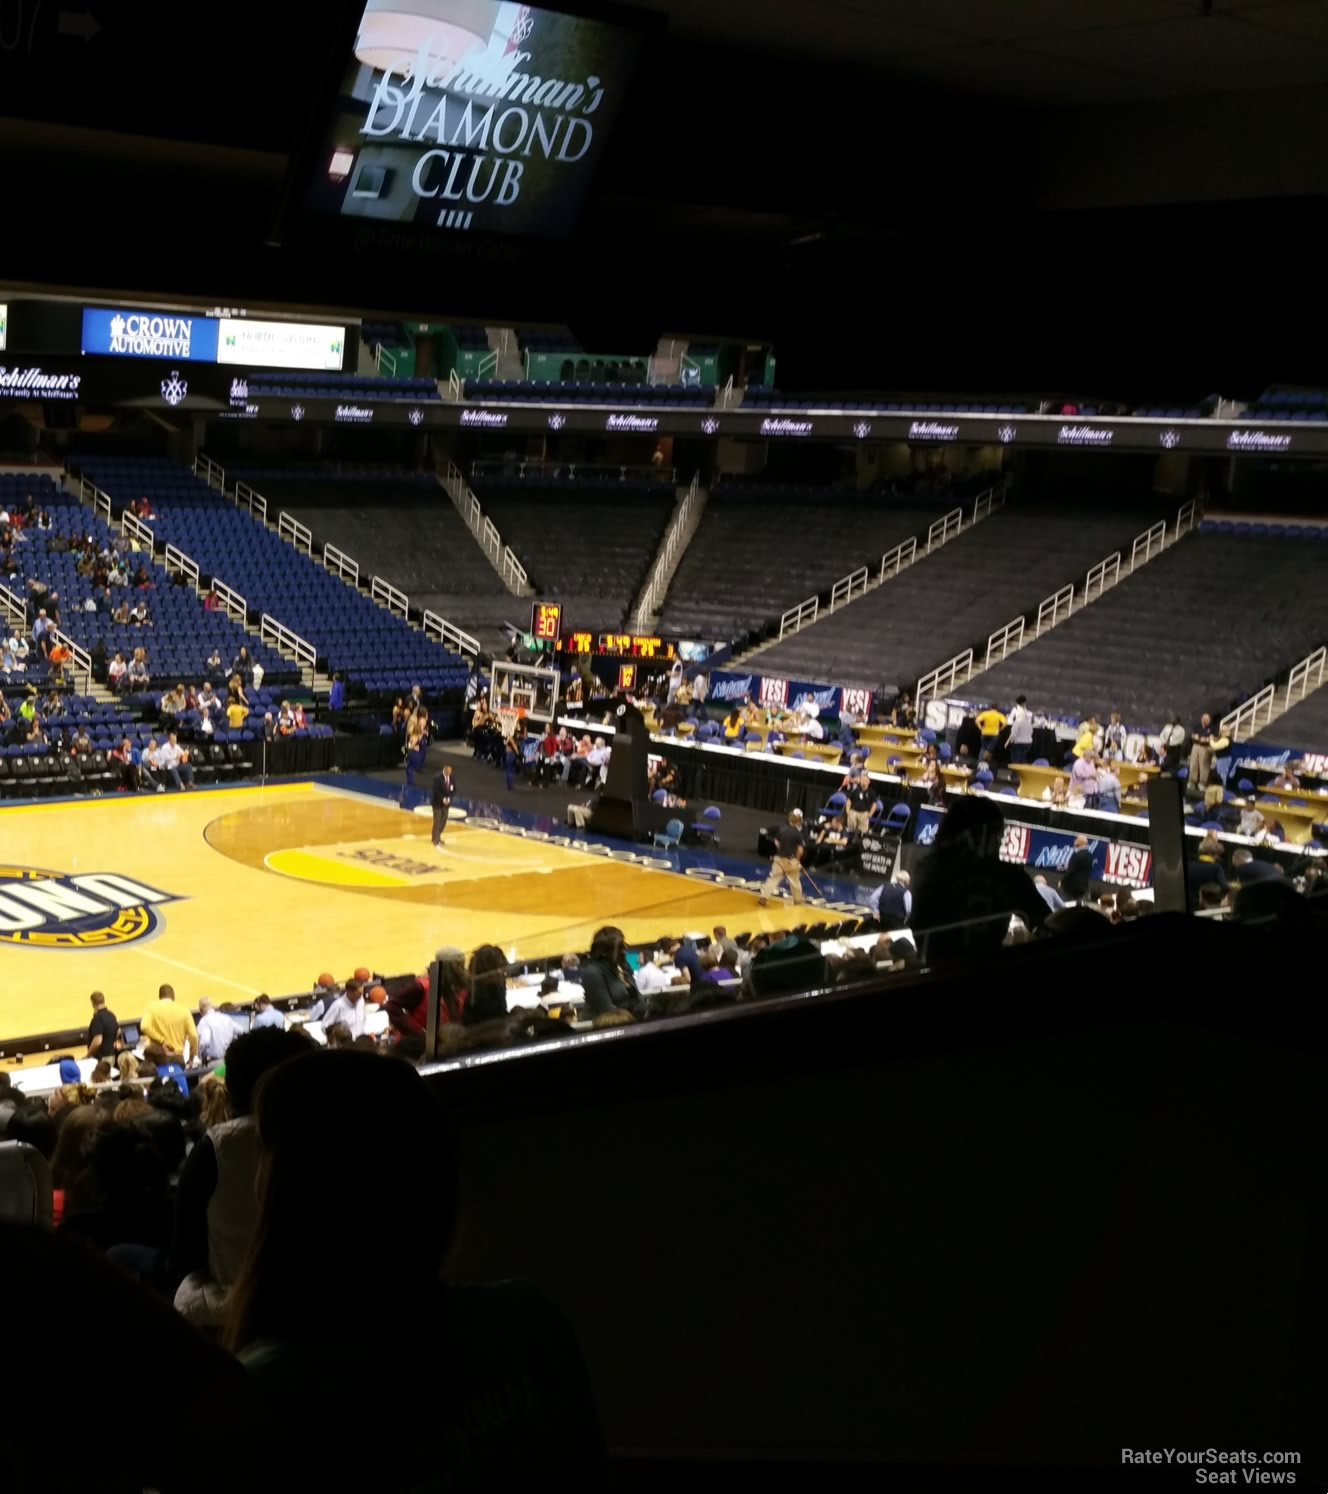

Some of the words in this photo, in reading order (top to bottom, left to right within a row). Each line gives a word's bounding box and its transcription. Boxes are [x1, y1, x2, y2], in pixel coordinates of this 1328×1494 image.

[359, 82, 594, 163] DIAMOND
[411, 148, 525, 206] CLUB
[126, 315, 193, 337] CROWN
[109, 336, 191, 358] AUTOMOTIVE
[335, 405, 374, 418] Schillman's
[460, 410, 509, 424] Schillman's
[606, 413, 659, 428] Schillman's
[760, 418, 814, 433] Schillman's
[909, 421, 959, 435] Schillman's
[1058, 425, 1114, 440] Schillman's
[1227, 430, 1292, 446] Schillman's
[539, 618, 555, 637] 30
[761, 677, 787, 705] YES!
[843, 688, 870, 714] YES!
[1108, 843, 1149, 880] YES!
